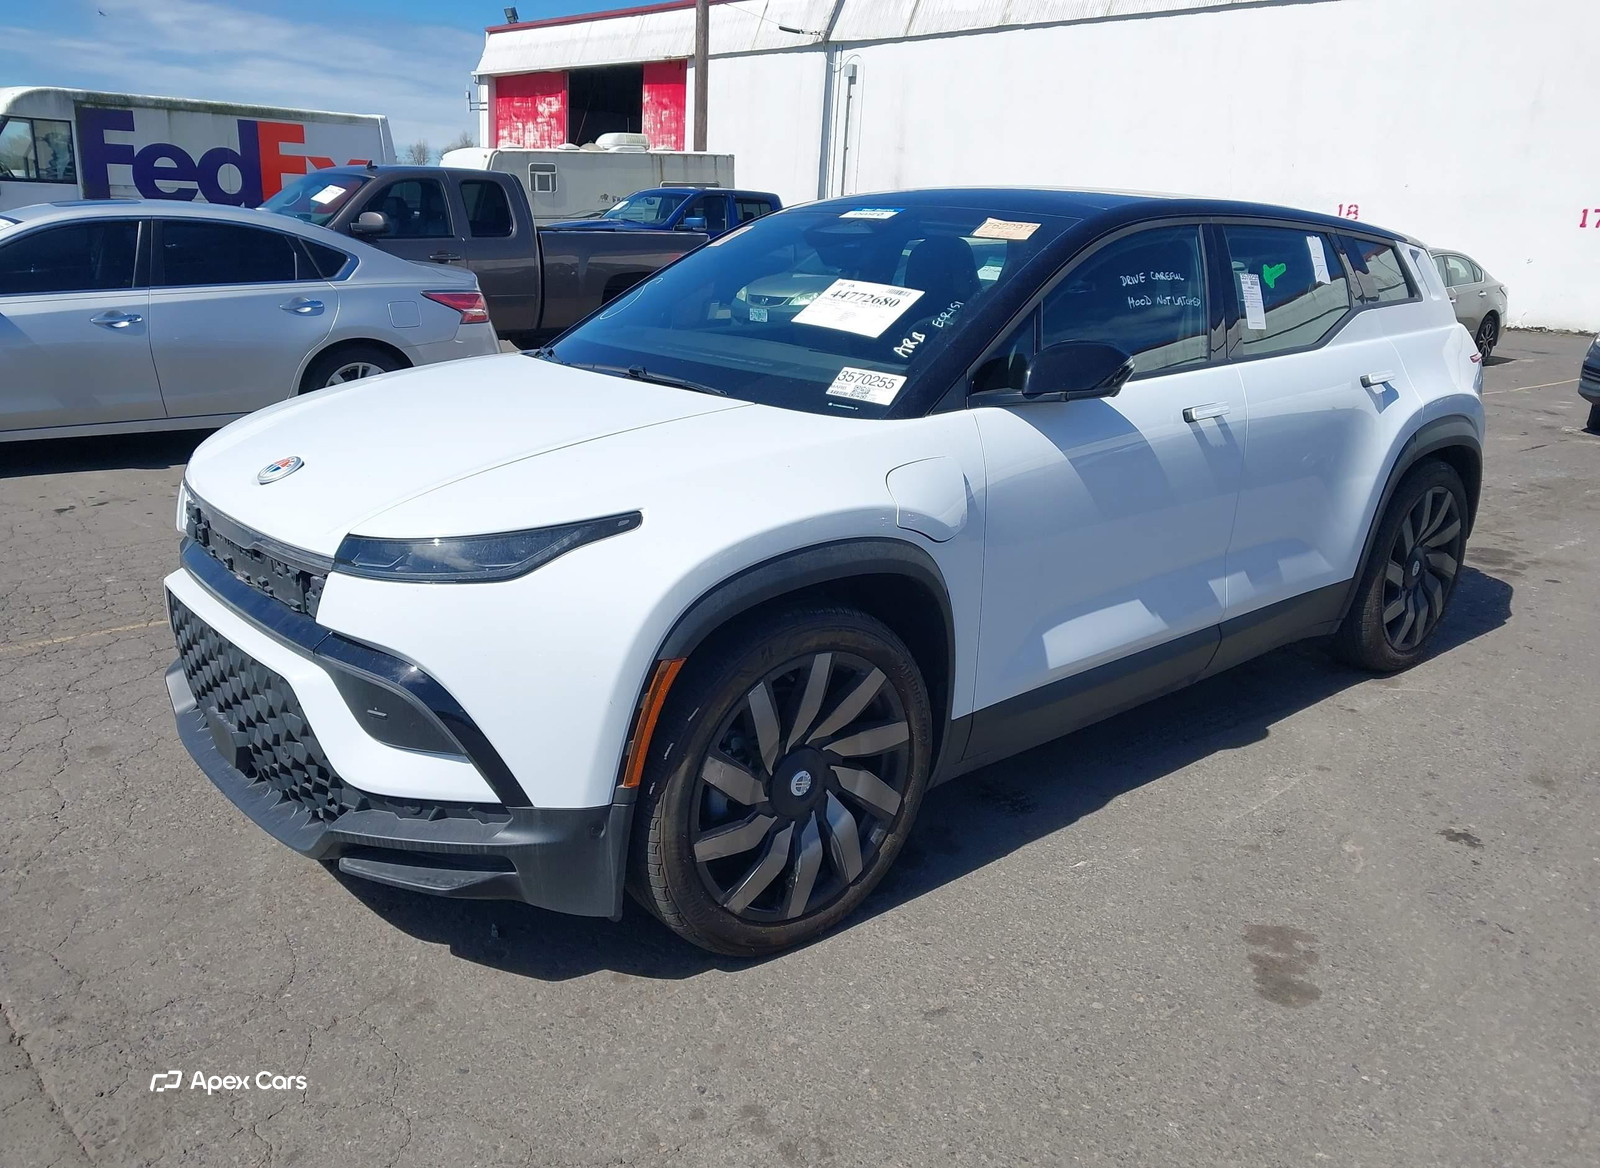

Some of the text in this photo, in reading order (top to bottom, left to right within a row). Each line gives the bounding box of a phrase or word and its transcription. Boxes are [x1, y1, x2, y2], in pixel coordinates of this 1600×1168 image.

[81, 107, 369, 207] FedE
[1120, 271, 1185, 287] DRIVE CAREFUL
[830, 289, 901, 308] 44772680
[837, 370, 898, 390] 3570255
